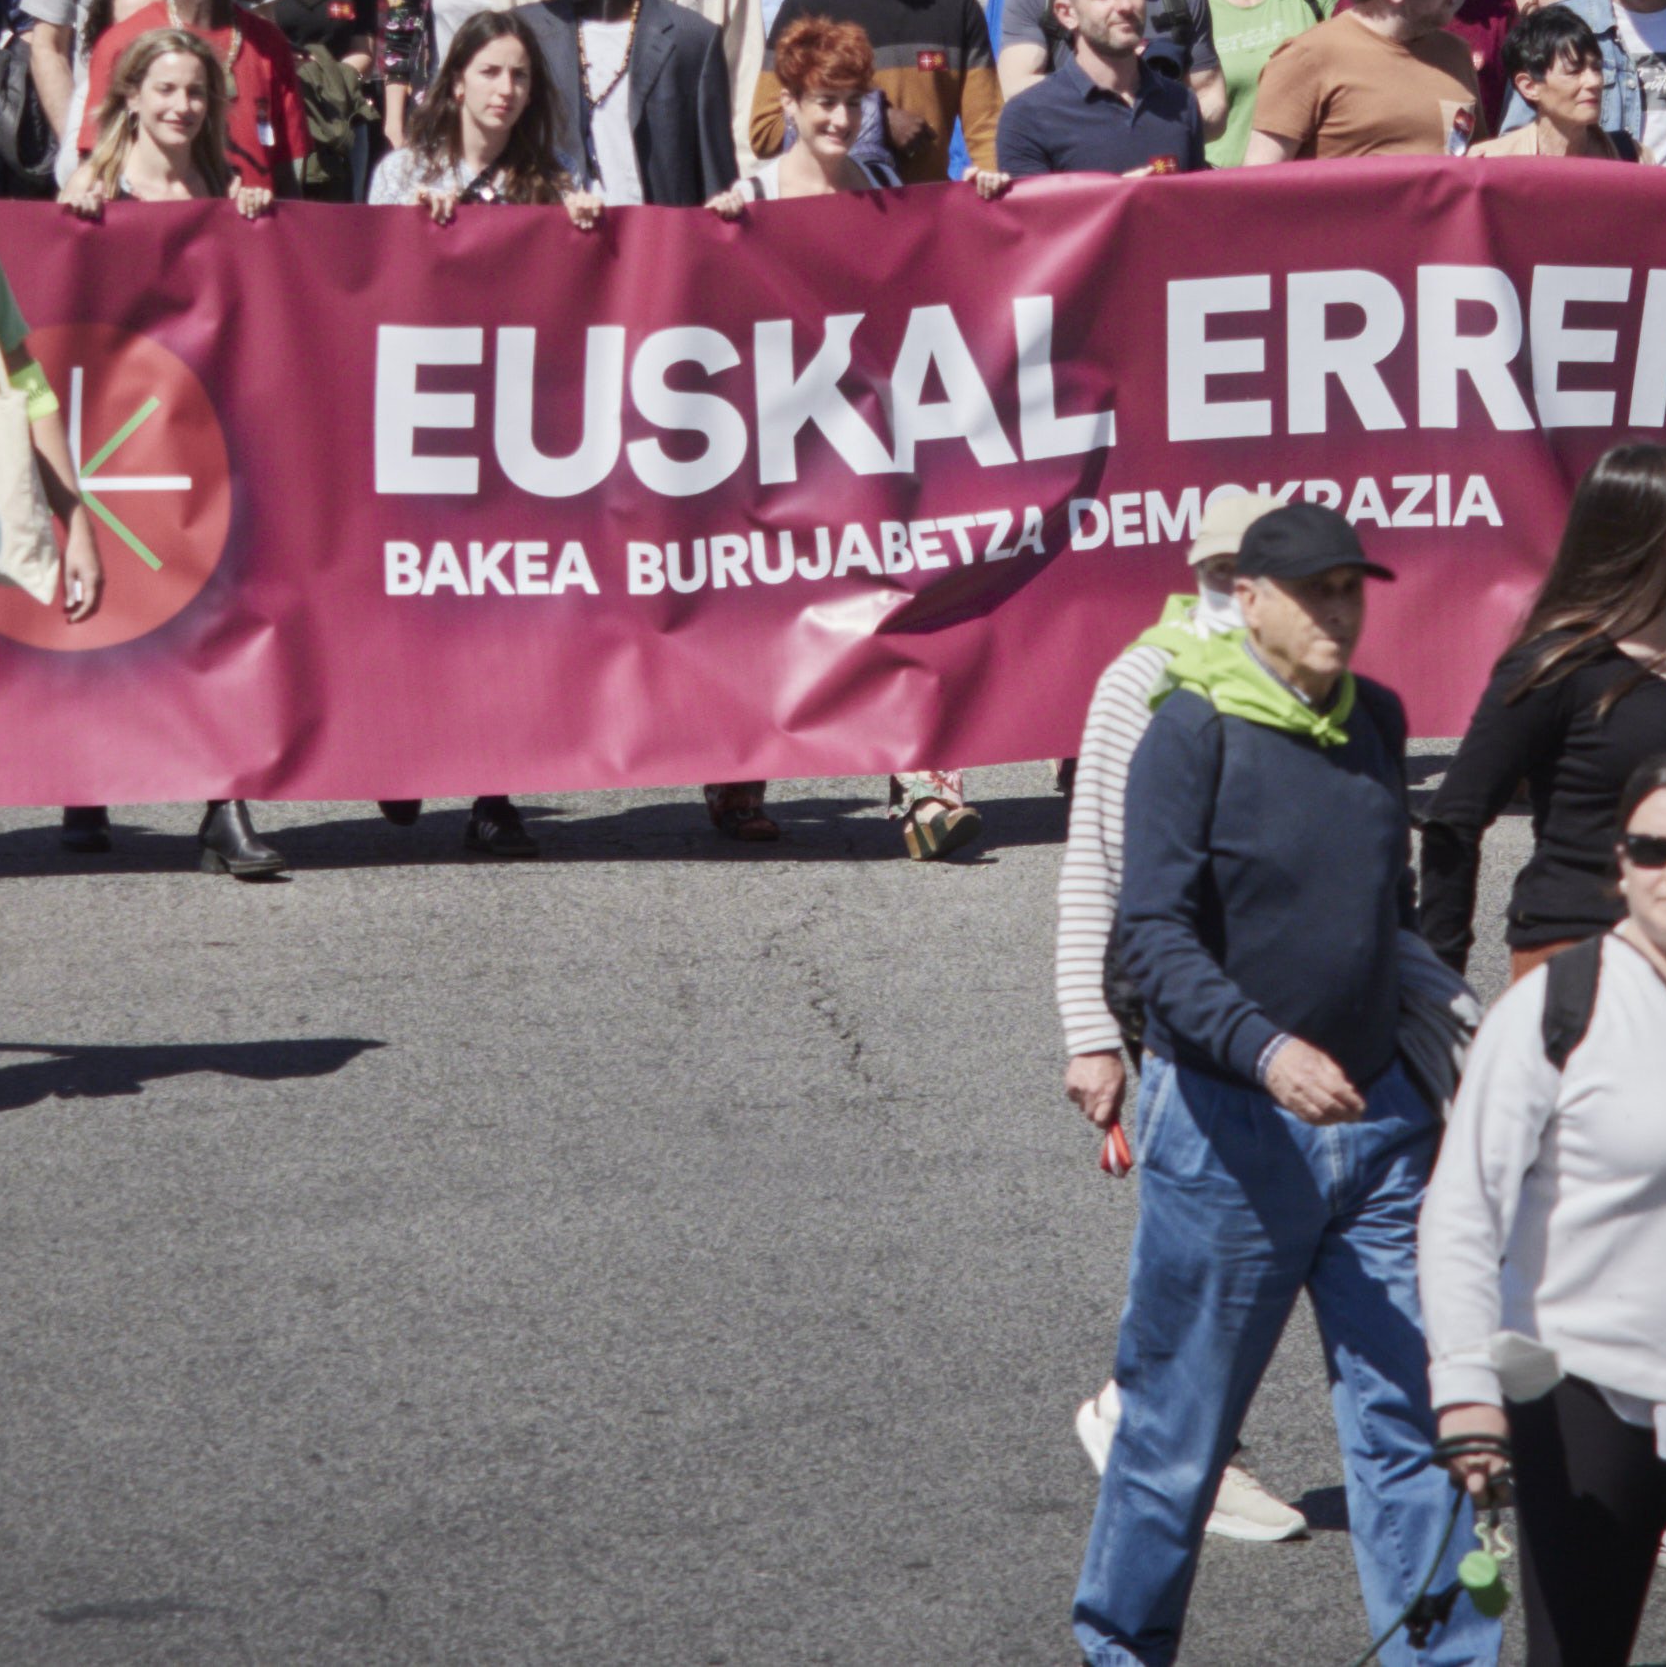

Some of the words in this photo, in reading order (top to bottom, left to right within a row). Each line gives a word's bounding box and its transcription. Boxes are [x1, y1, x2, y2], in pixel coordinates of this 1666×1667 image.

[374, 295, 1116, 497] EUSKAL
[385, 541, 600, 596] BAKEA
[628, 506, 1045, 595] BURUJABETZA
